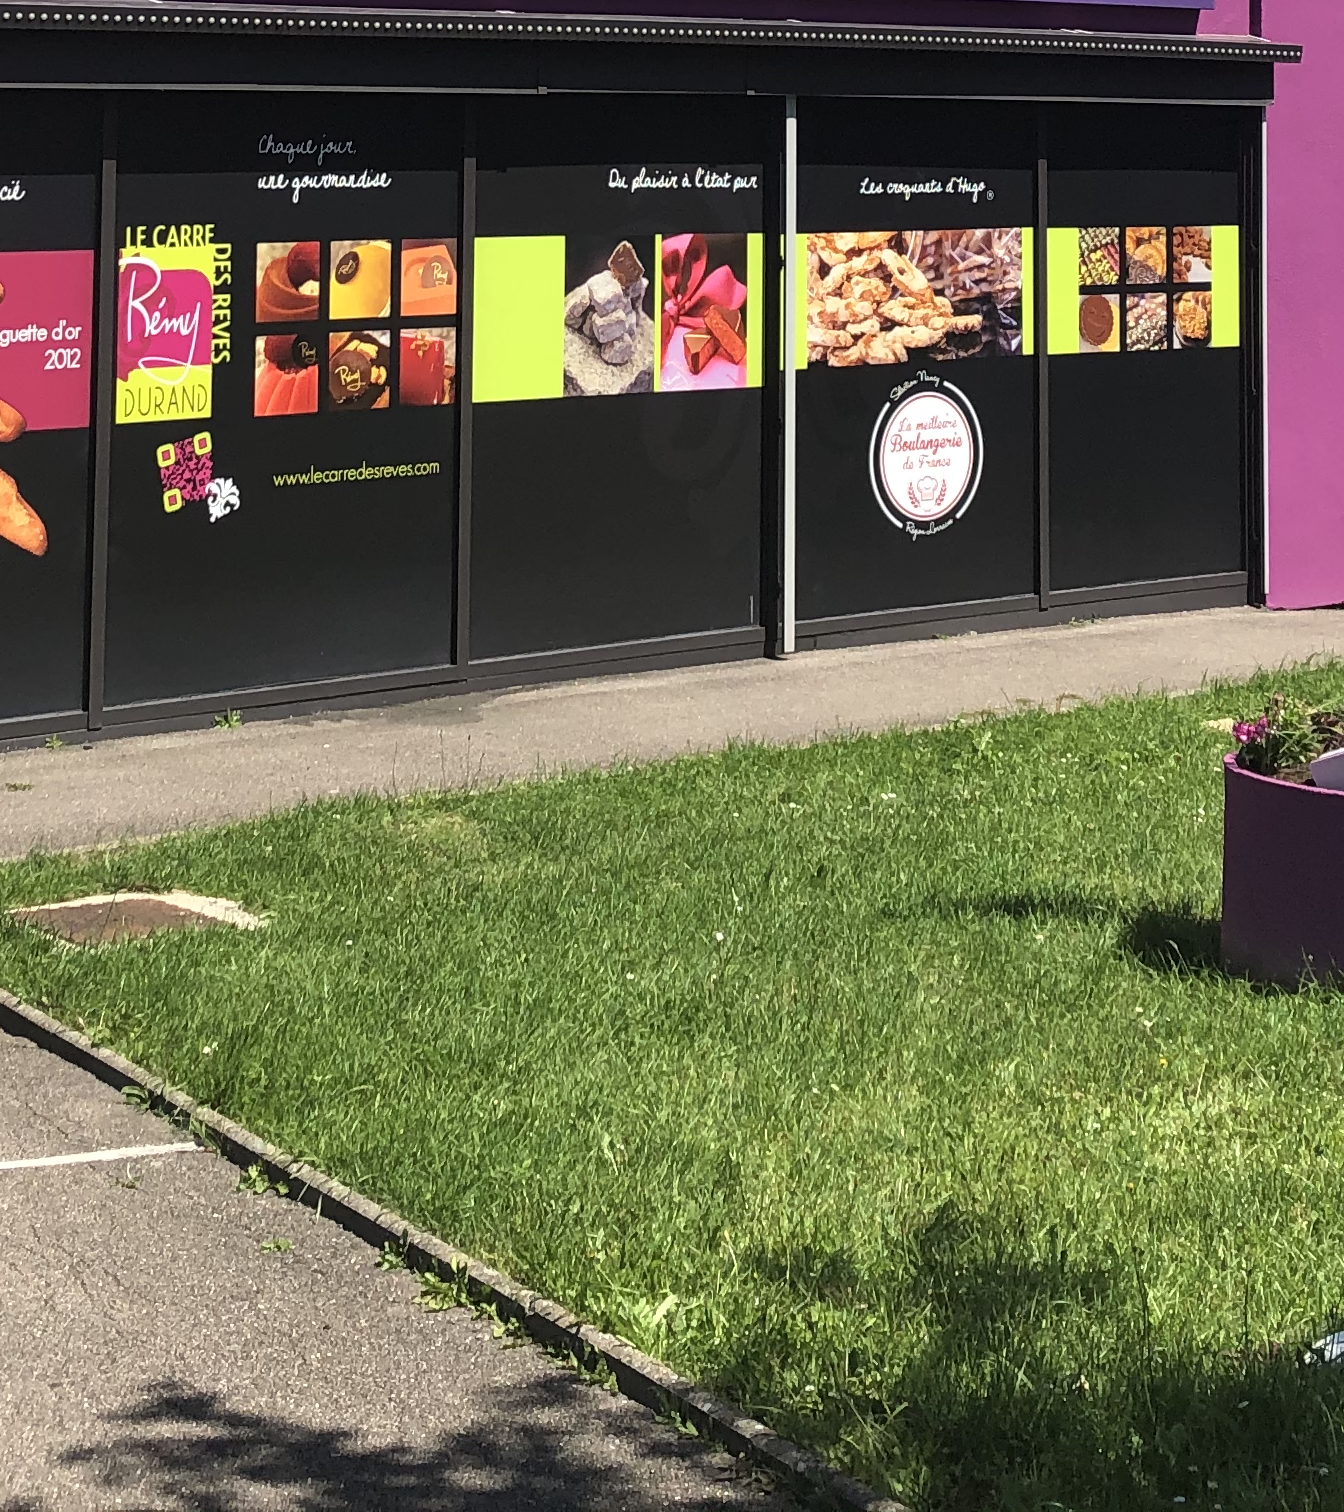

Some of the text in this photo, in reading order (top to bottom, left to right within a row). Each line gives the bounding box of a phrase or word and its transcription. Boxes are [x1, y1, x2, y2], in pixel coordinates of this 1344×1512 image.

[258, 134, 317, 164] Chaque
[257, 168, 392, 204] une gourmandise
[608, 167, 758, 193] Du plaisir à l'état pur
[860, 177, 884, 194] Les
[887, 179, 943, 201] croquants
[126, 224, 215, 248] LE CARRE
[211, 243, 232, 286] DES
[51, 319, 82, 340] d'or
[118, 256, 212, 385] Rémy
[211, 293, 232, 364] REVES
[44, 347, 81, 370] 2012
[124, 384, 208, 418] DURAND
[898, 417, 912, 432] La
[890, 431, 962, 455] Boulangerie
[273, 461, 440, 486] www.lecarredesreves.com
